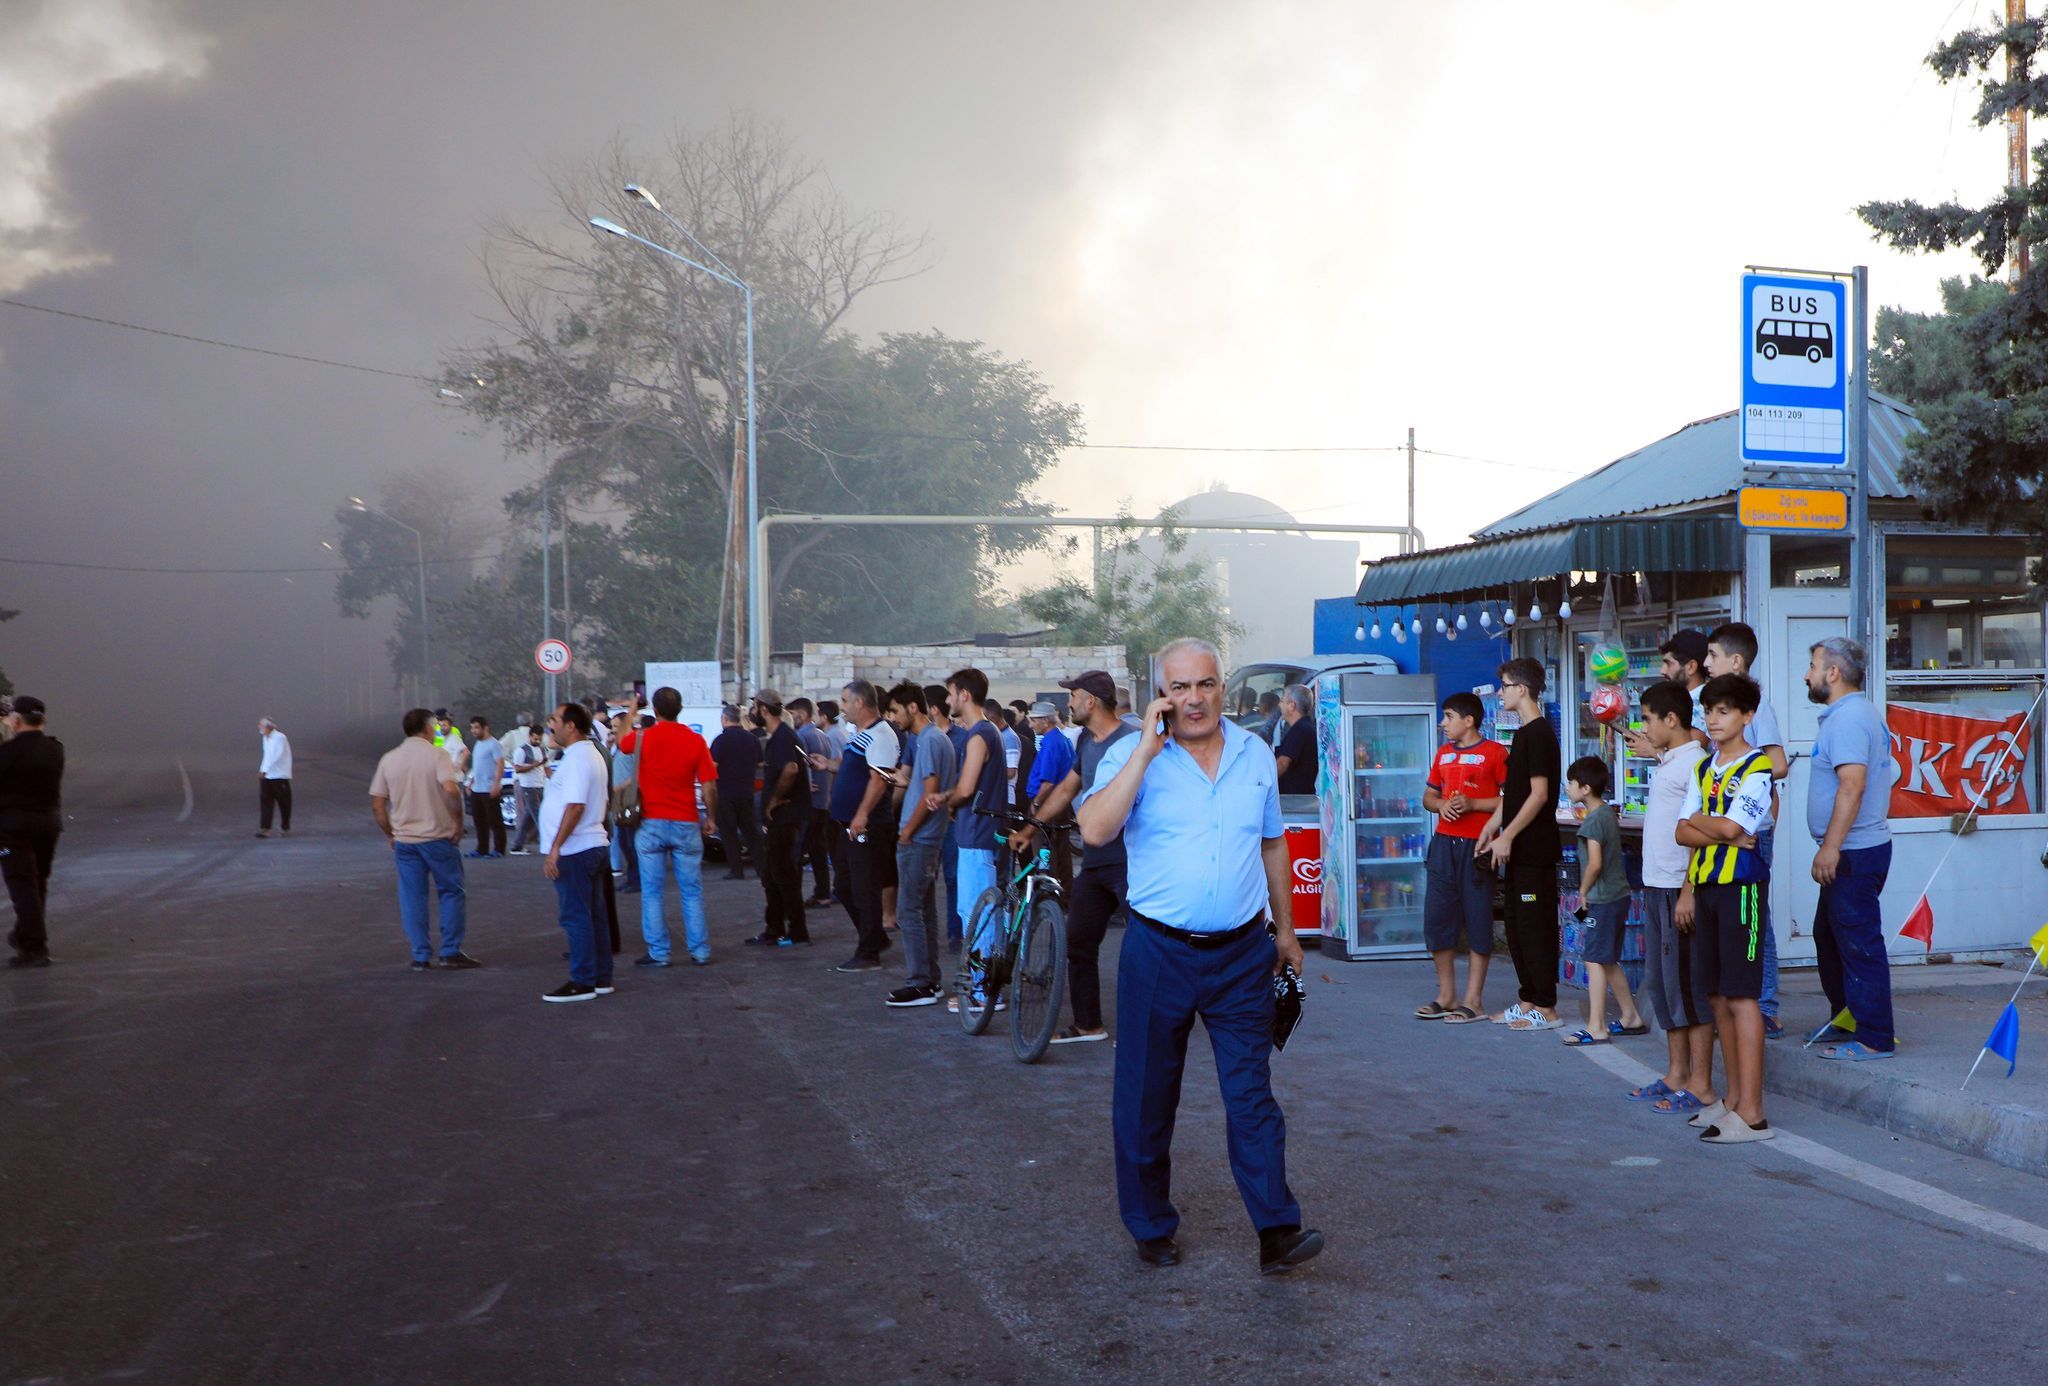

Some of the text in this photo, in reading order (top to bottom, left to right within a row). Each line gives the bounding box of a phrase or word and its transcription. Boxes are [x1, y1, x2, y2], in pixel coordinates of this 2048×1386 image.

[1771, 295, 1818, 315] BUS
[1748, 408, 1803, 420] 104 113 209
[544, 649, 563, 664] 50
